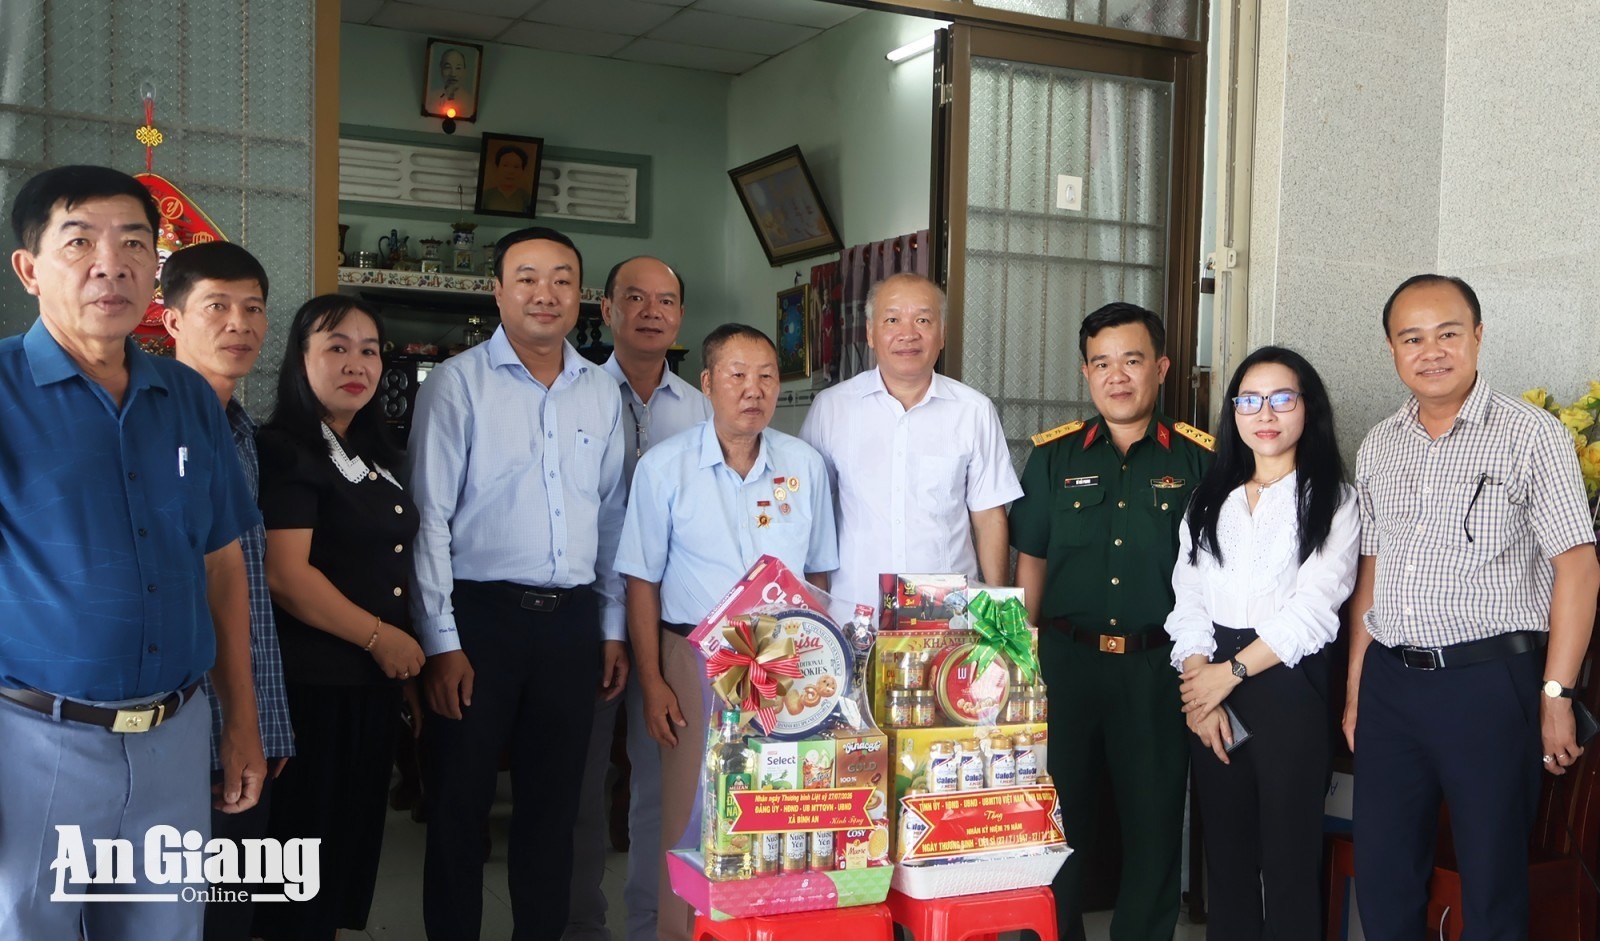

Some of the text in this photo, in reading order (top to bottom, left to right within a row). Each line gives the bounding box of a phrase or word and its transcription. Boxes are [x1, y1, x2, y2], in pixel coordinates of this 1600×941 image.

[957, 667, 967, 680] LU
[767, 756, 796, 766] Select
[847, 761, 877, 773] GOLD
[811, 815, 819, 823] AN
